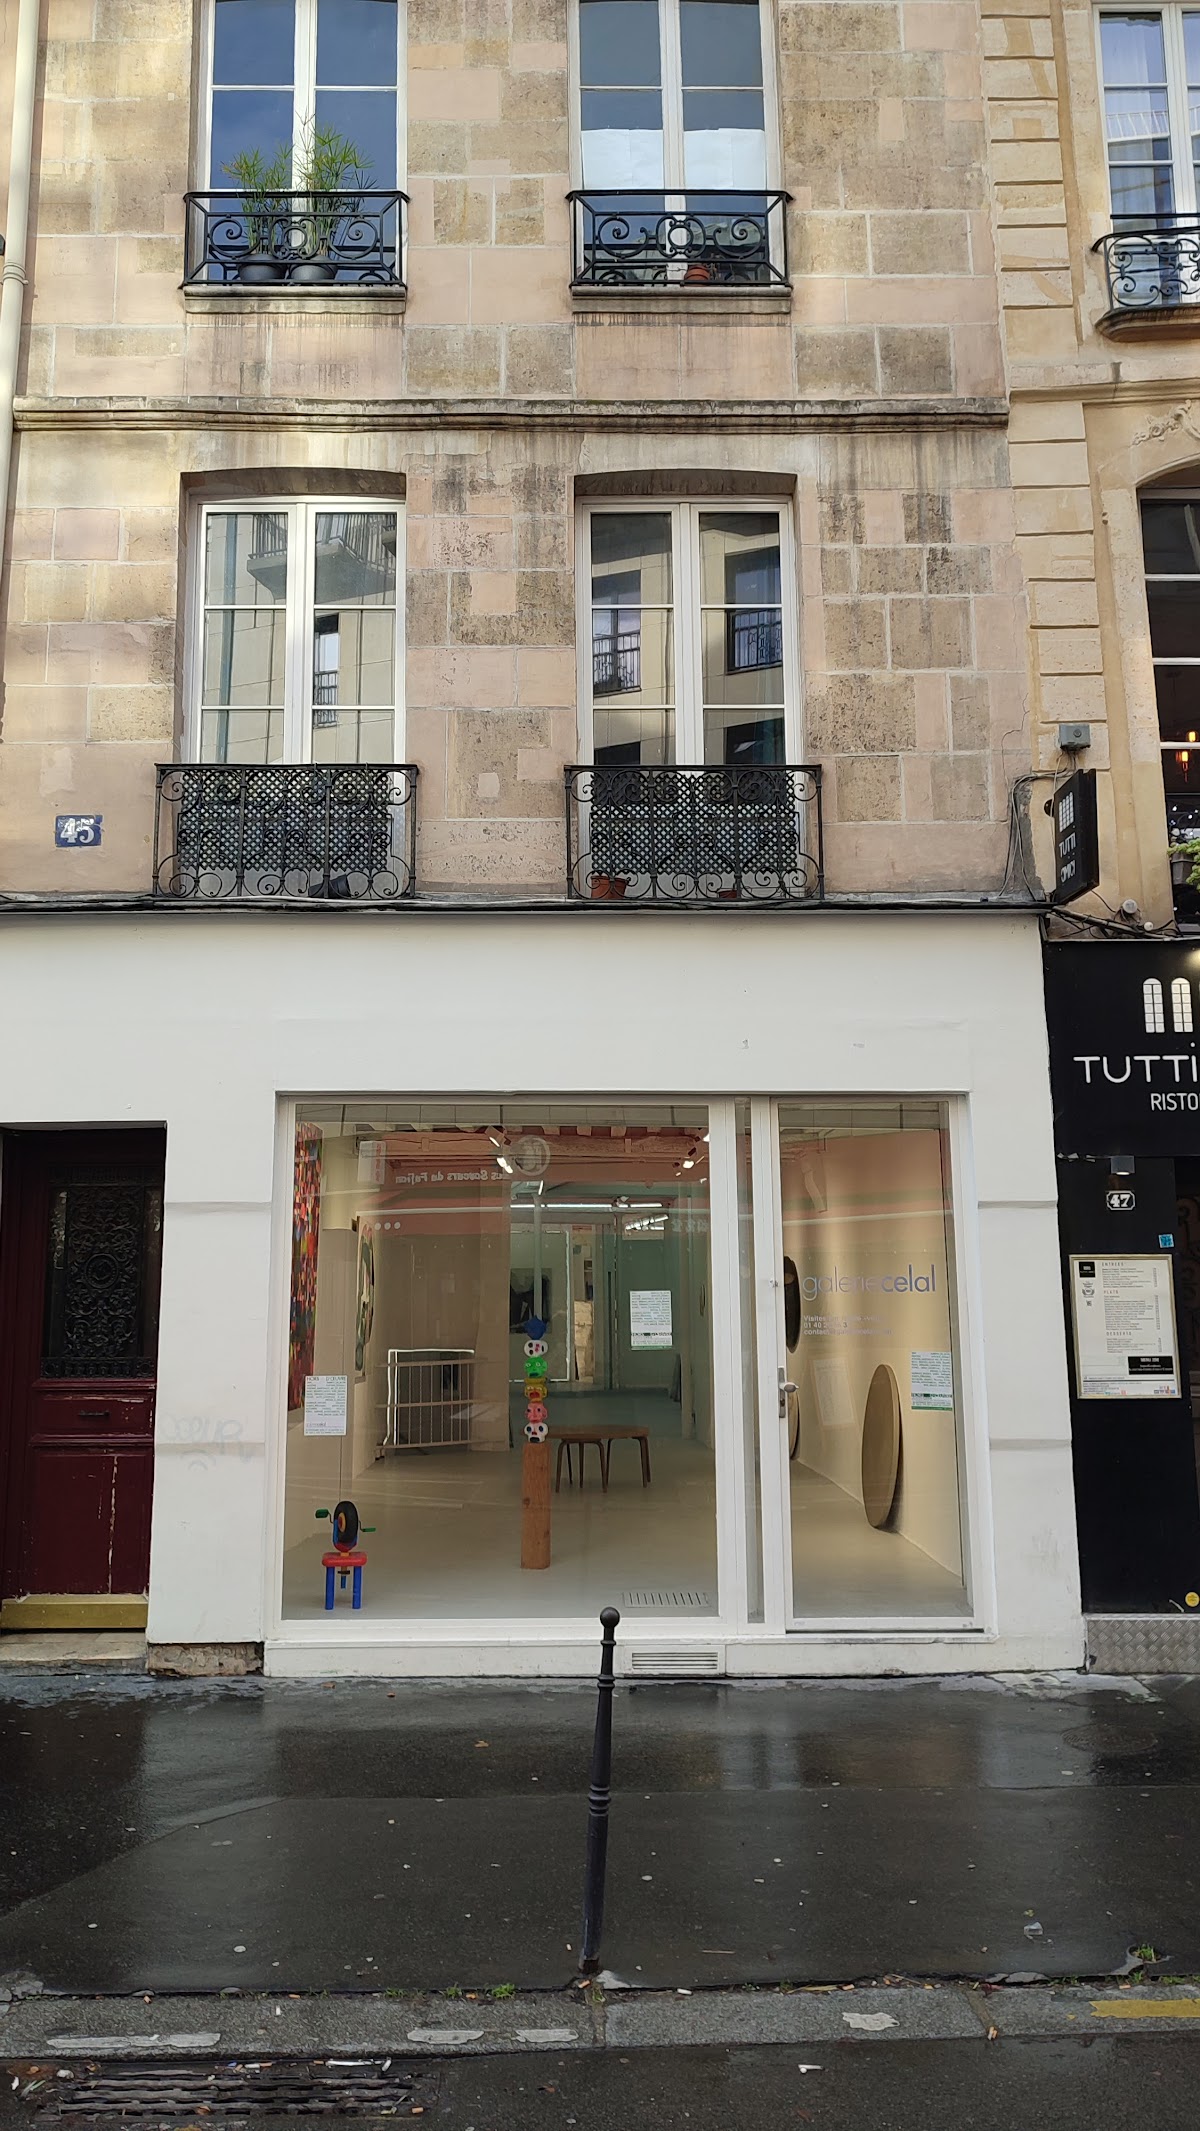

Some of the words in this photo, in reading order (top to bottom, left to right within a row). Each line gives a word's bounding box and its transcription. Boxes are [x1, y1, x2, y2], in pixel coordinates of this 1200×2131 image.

[60, 817, 95, 844] 45
[1150, 1092, 1200, 1111] RISTO
[1110, 1194, 1131, 1207] 47
